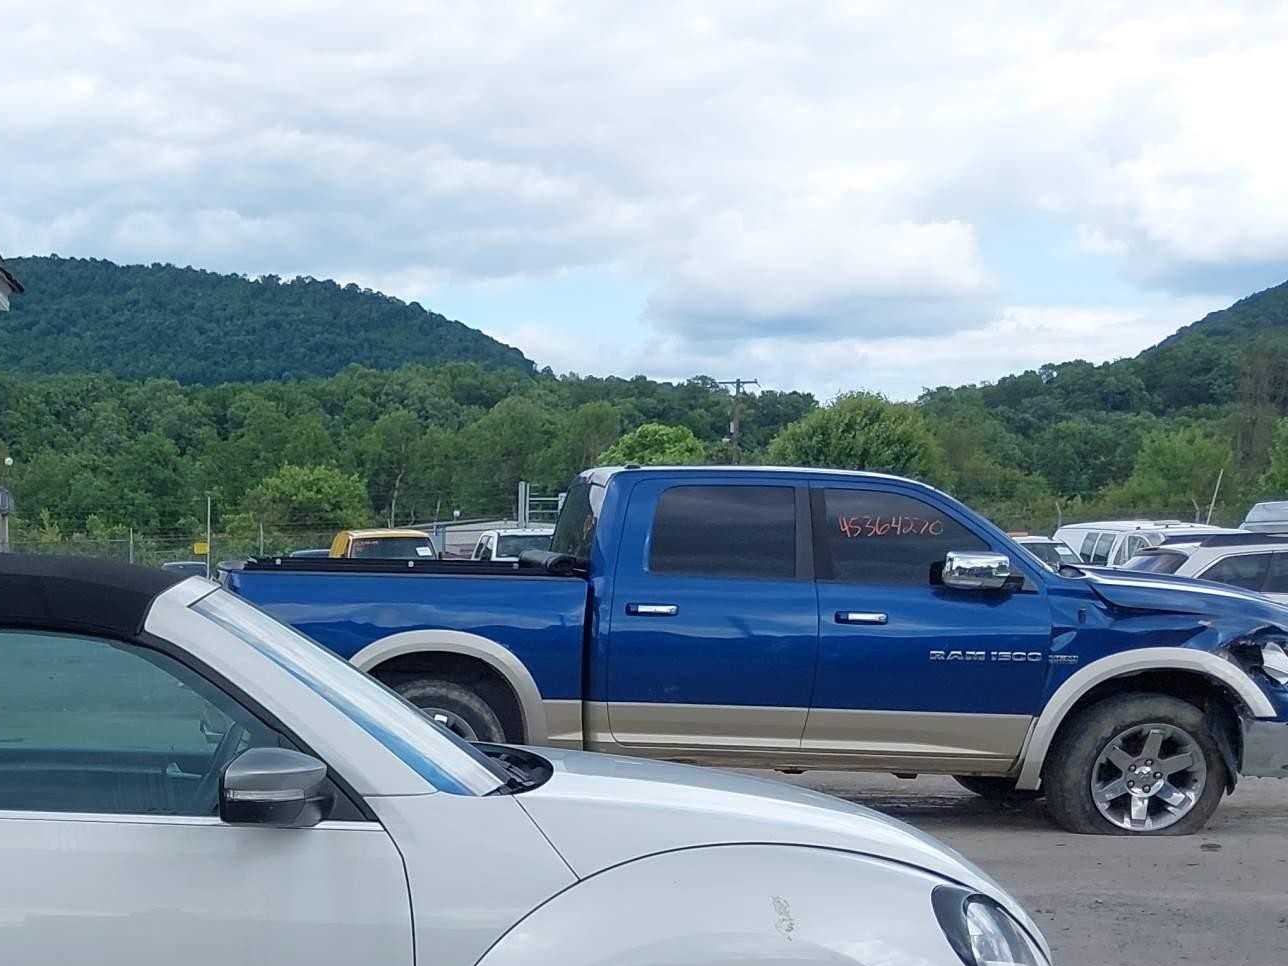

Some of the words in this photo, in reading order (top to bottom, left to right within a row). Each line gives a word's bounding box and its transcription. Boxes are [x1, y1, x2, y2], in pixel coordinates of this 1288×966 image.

[838, 515, 944, 538] 45364270
[929, 650, 986, 661] RAM
[991, 651, 1043, 662] 1500
